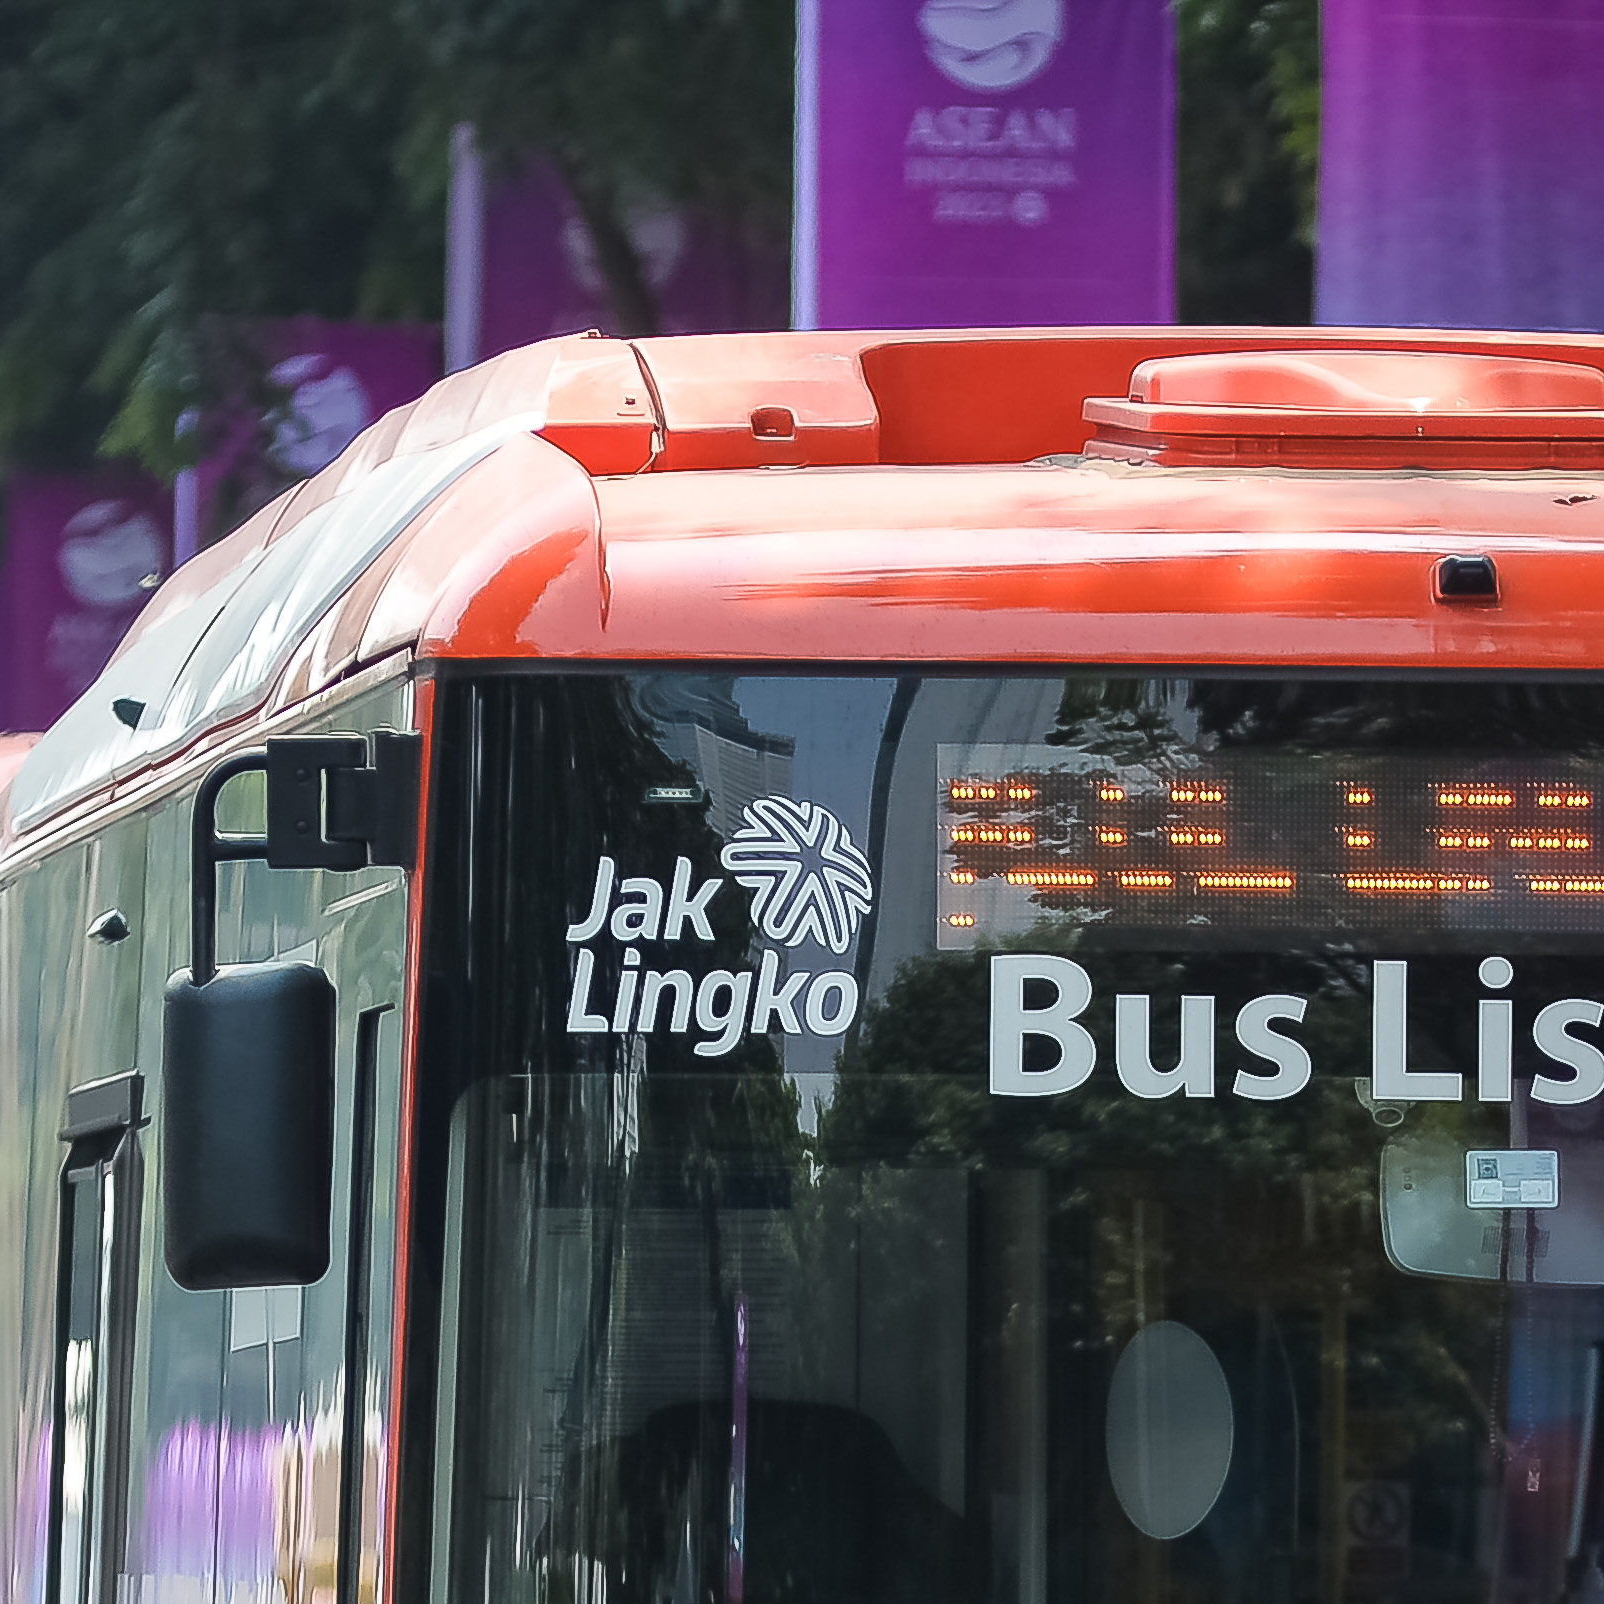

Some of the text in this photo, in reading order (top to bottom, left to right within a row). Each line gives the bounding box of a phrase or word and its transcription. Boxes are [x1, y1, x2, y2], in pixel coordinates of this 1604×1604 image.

[904, 106, 1078, 148] ASEAN
[566, 856, 723, 941] Jak
[567, 948, 859, 1057] Lingko
[989, 954, 1312, 1100] Bus
